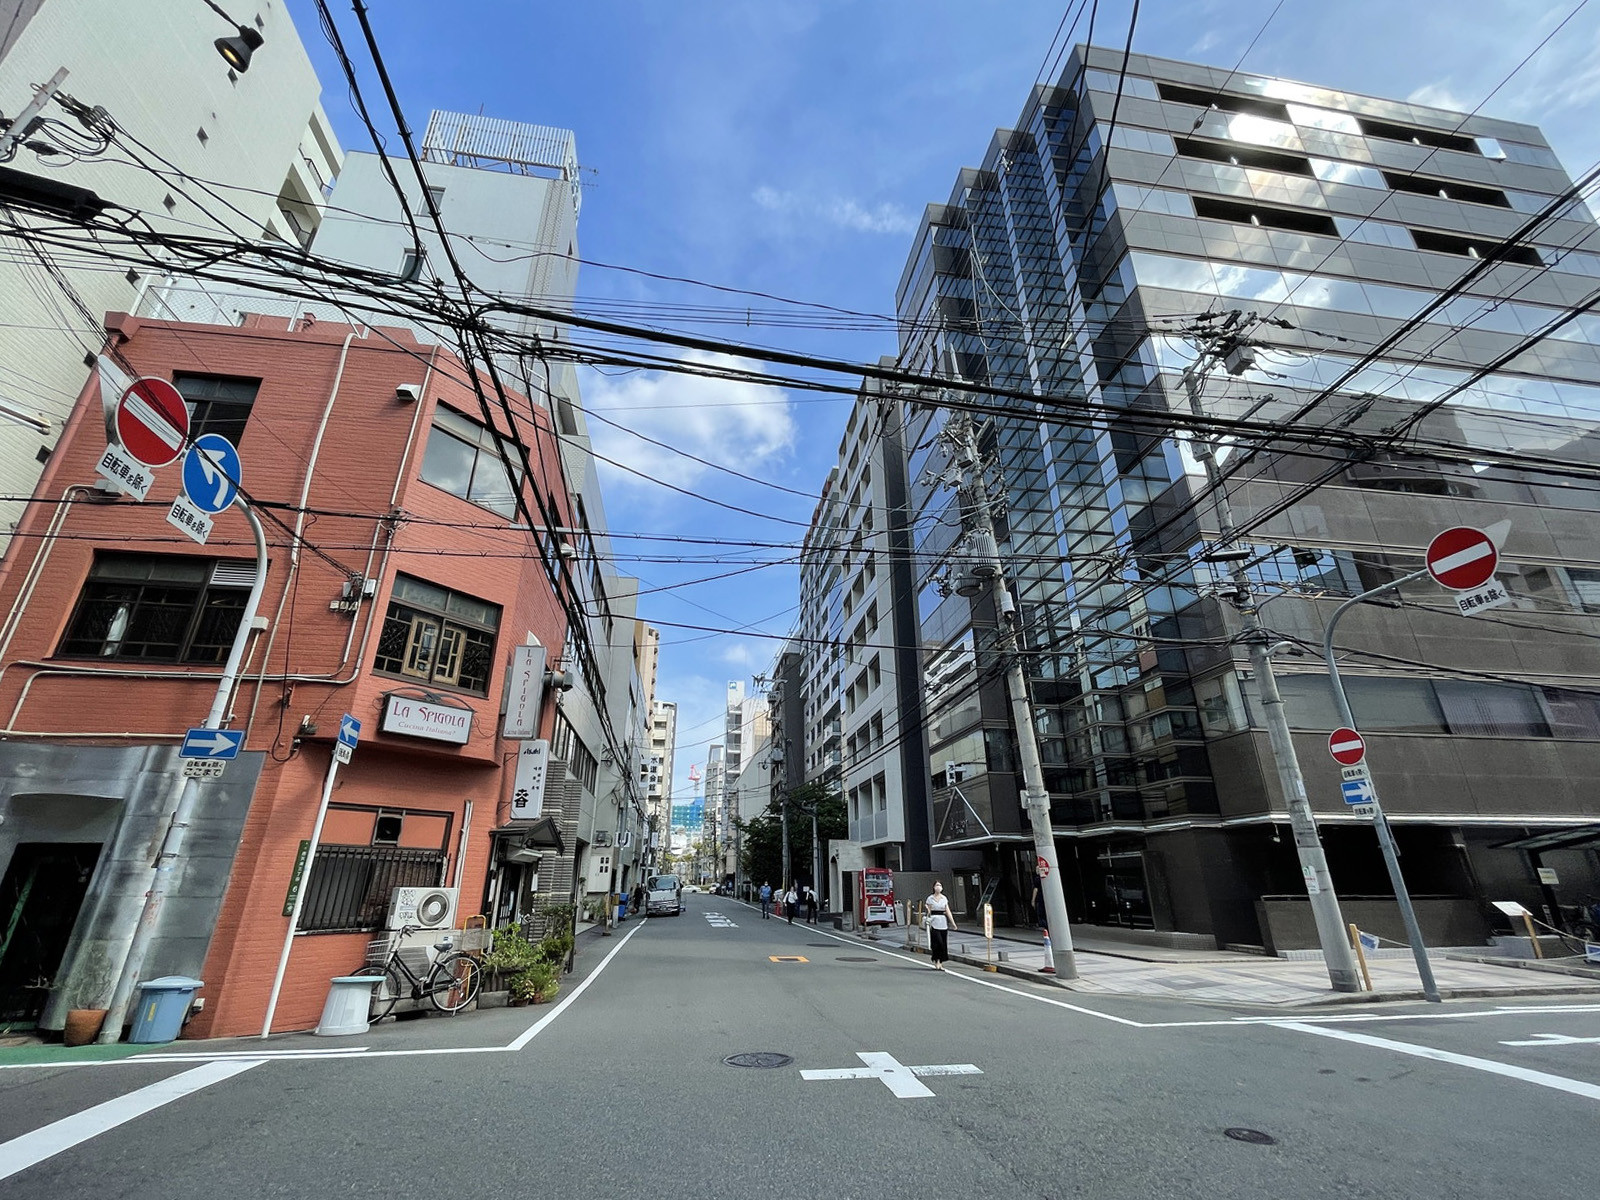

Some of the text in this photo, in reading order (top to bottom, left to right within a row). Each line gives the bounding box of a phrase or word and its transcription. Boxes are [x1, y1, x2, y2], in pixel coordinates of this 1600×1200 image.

[101, 452, 148, 494] 自転車を除く
[171, 504, 208, 538] 自転車を除く
[1459, 589, 1506, 611] 自転車を除く
[524, 747, 541, 755] Asahi
[184, 768, 221, 776] ここまで
